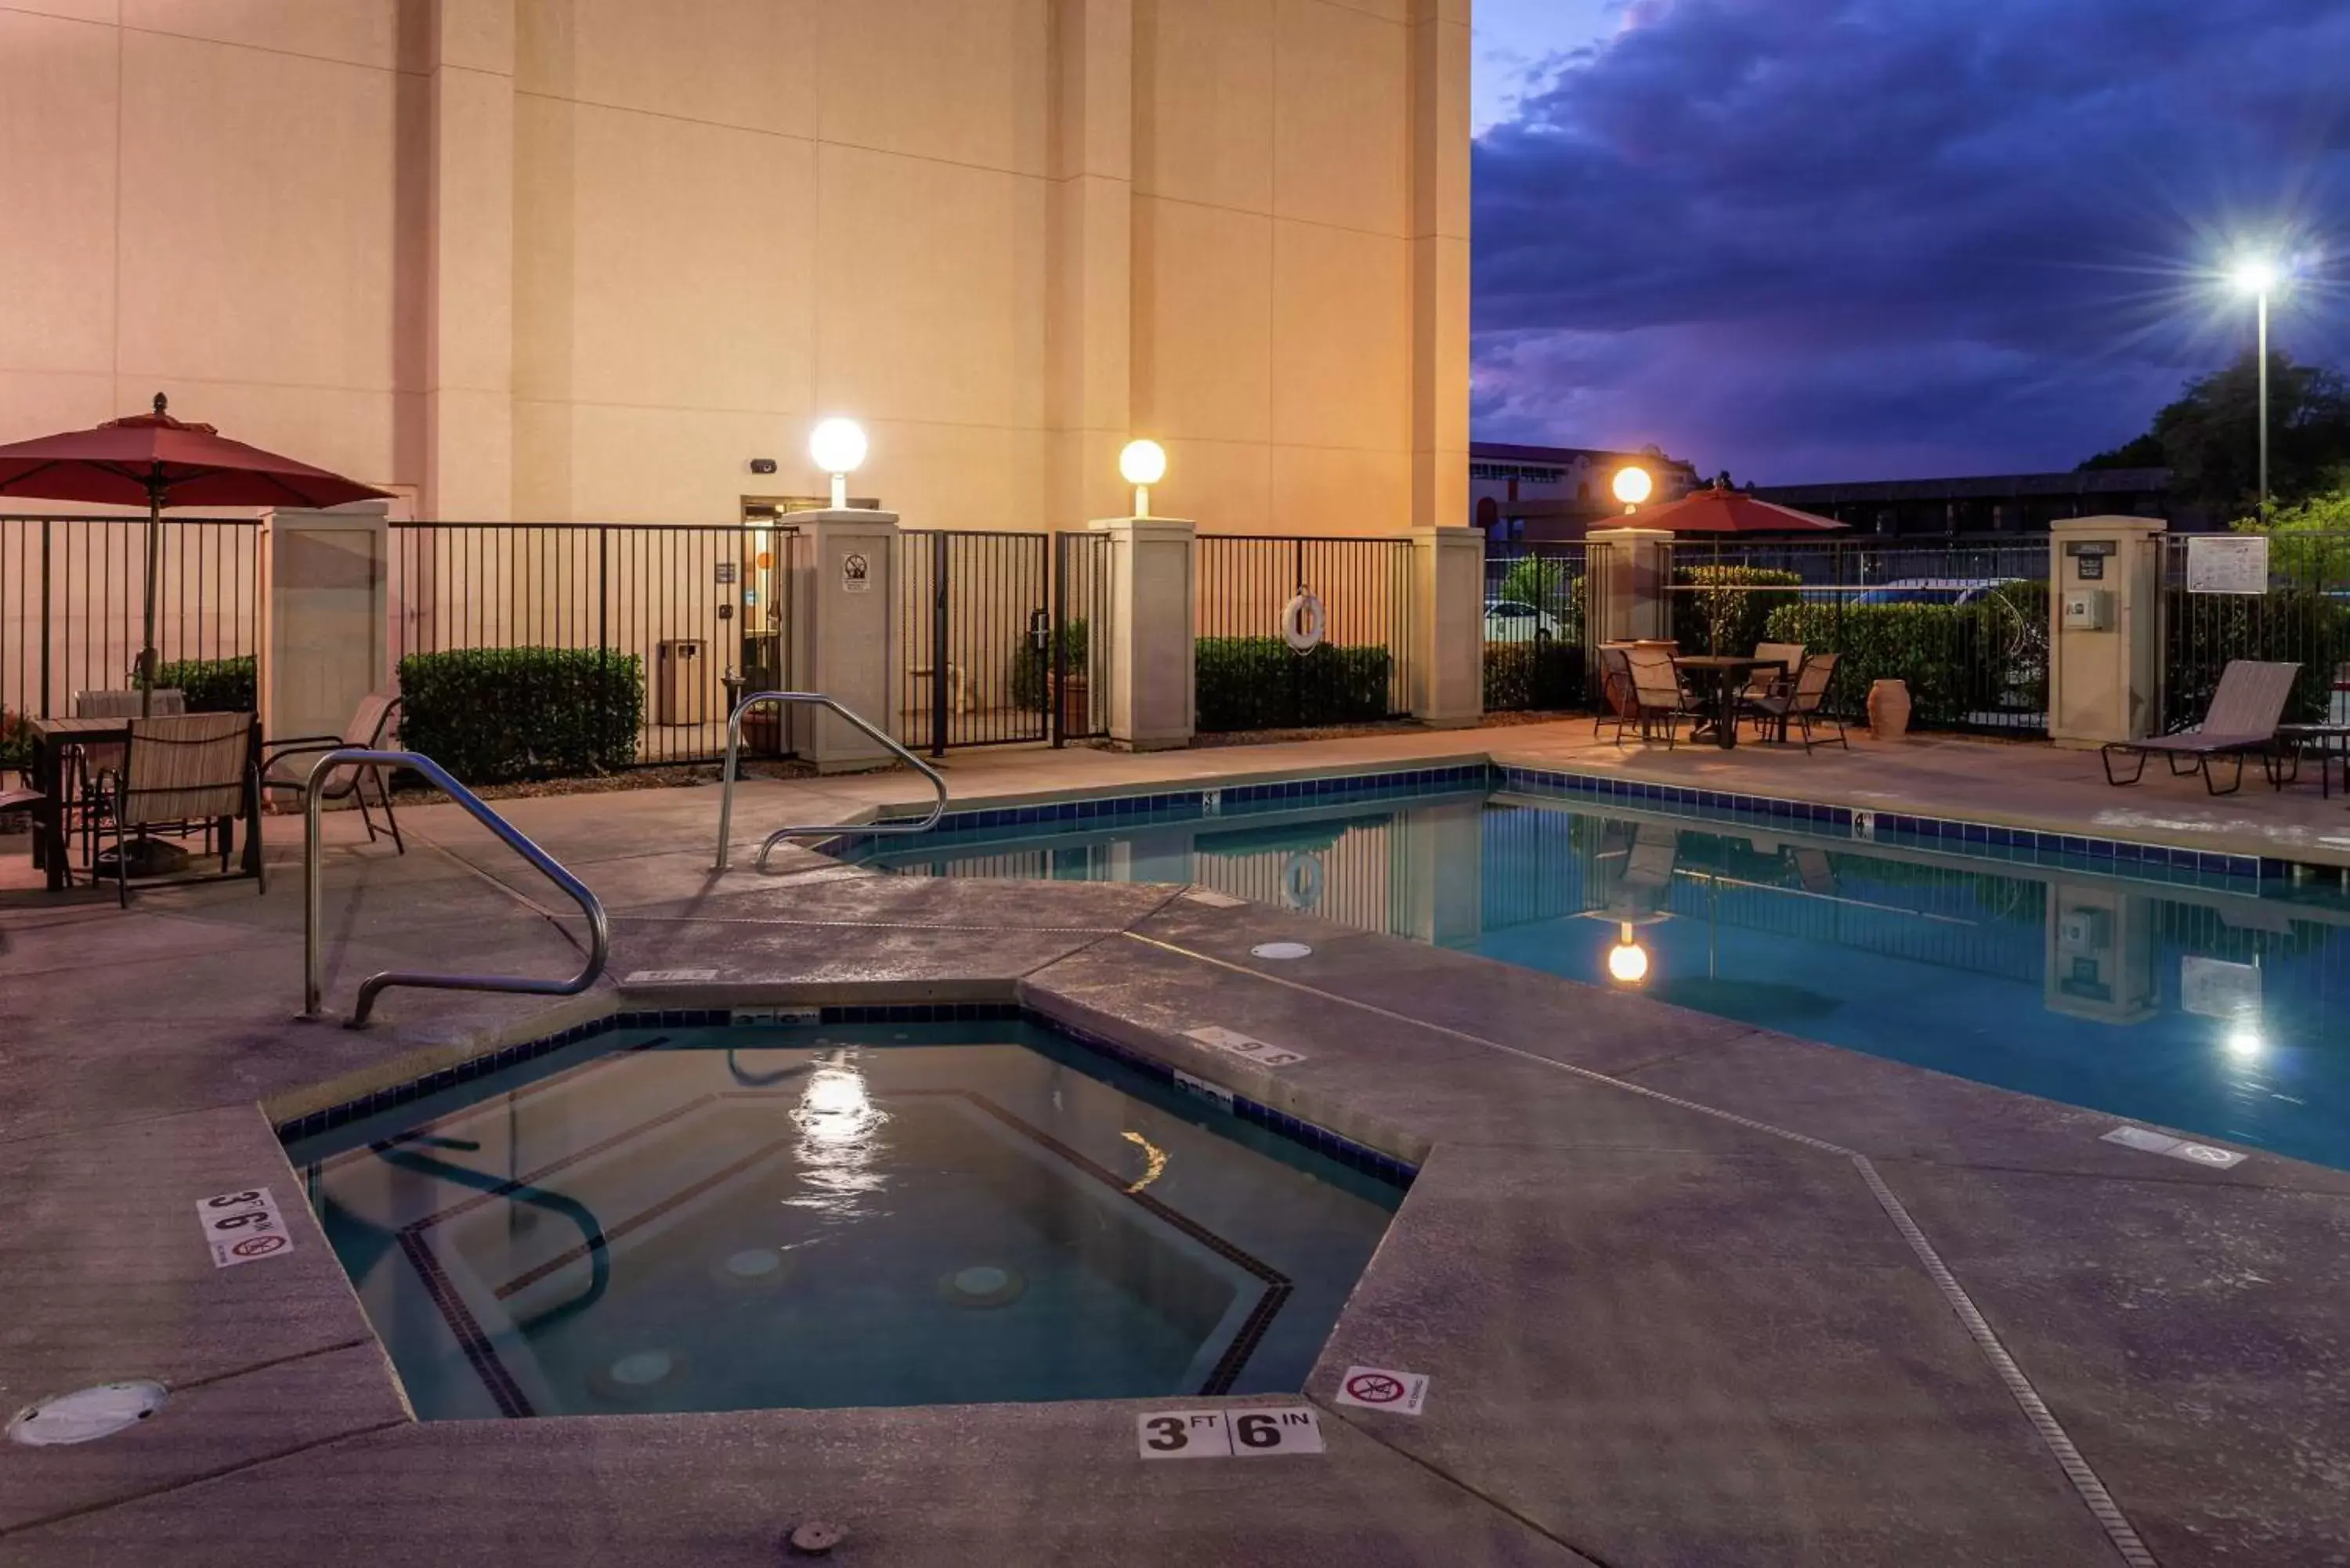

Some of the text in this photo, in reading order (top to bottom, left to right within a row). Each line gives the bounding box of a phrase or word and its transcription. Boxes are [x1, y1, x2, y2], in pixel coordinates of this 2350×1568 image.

[208, 1191, 260, 1208] 3
[215, 1212, 269, 1230] 6
[1146, 1413, 1309, 1451] 3 FT 6 IN
